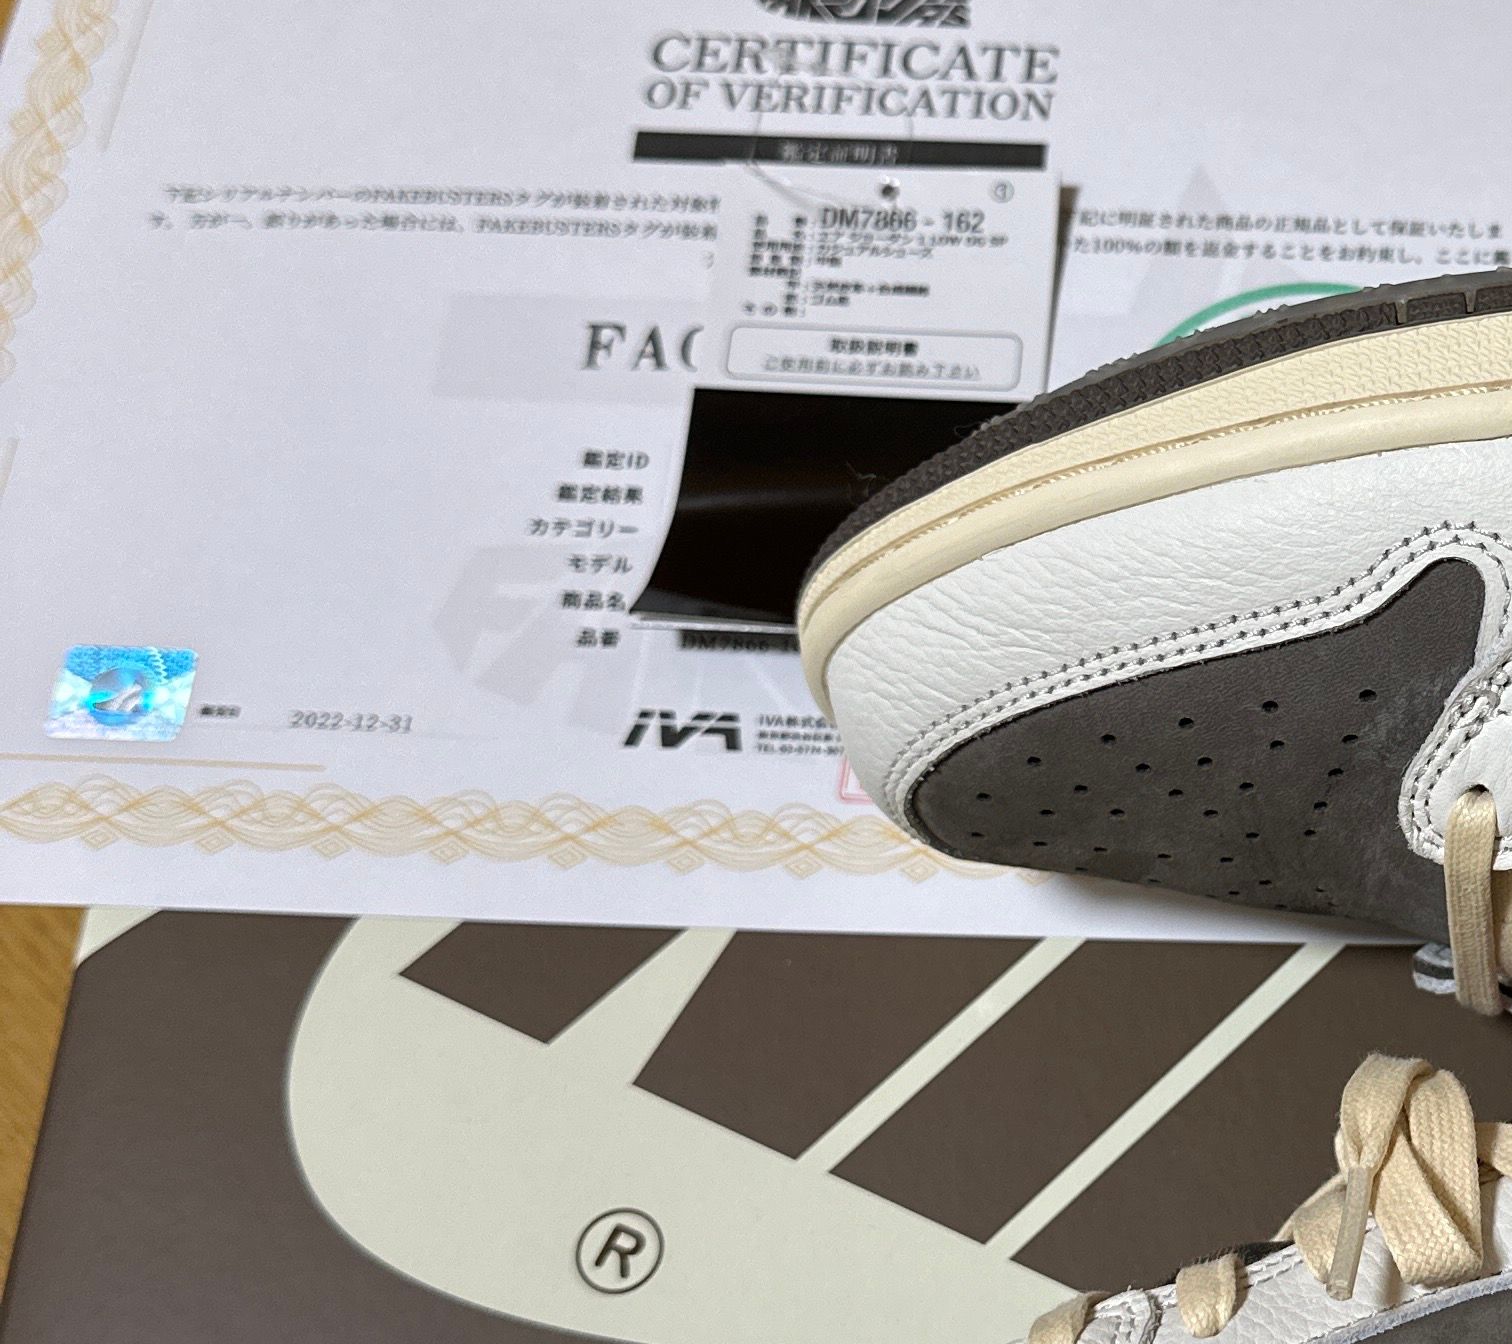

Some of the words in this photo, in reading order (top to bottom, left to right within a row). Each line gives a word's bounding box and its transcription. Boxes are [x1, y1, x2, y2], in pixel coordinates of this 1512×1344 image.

[650, 32, 1060, 85] CERTIFICATE
[644, 76, 709, 111] OF
[721, 80, 1056, 122] VERIFICATION
[943, 211, 986, 234] 162
[528, 517, 639, 538] カテゴリー
[567, 554, 633, 574] モデル
[560, 590, 627, 611] 商品名
[624, 709, 742, 751] IVA
